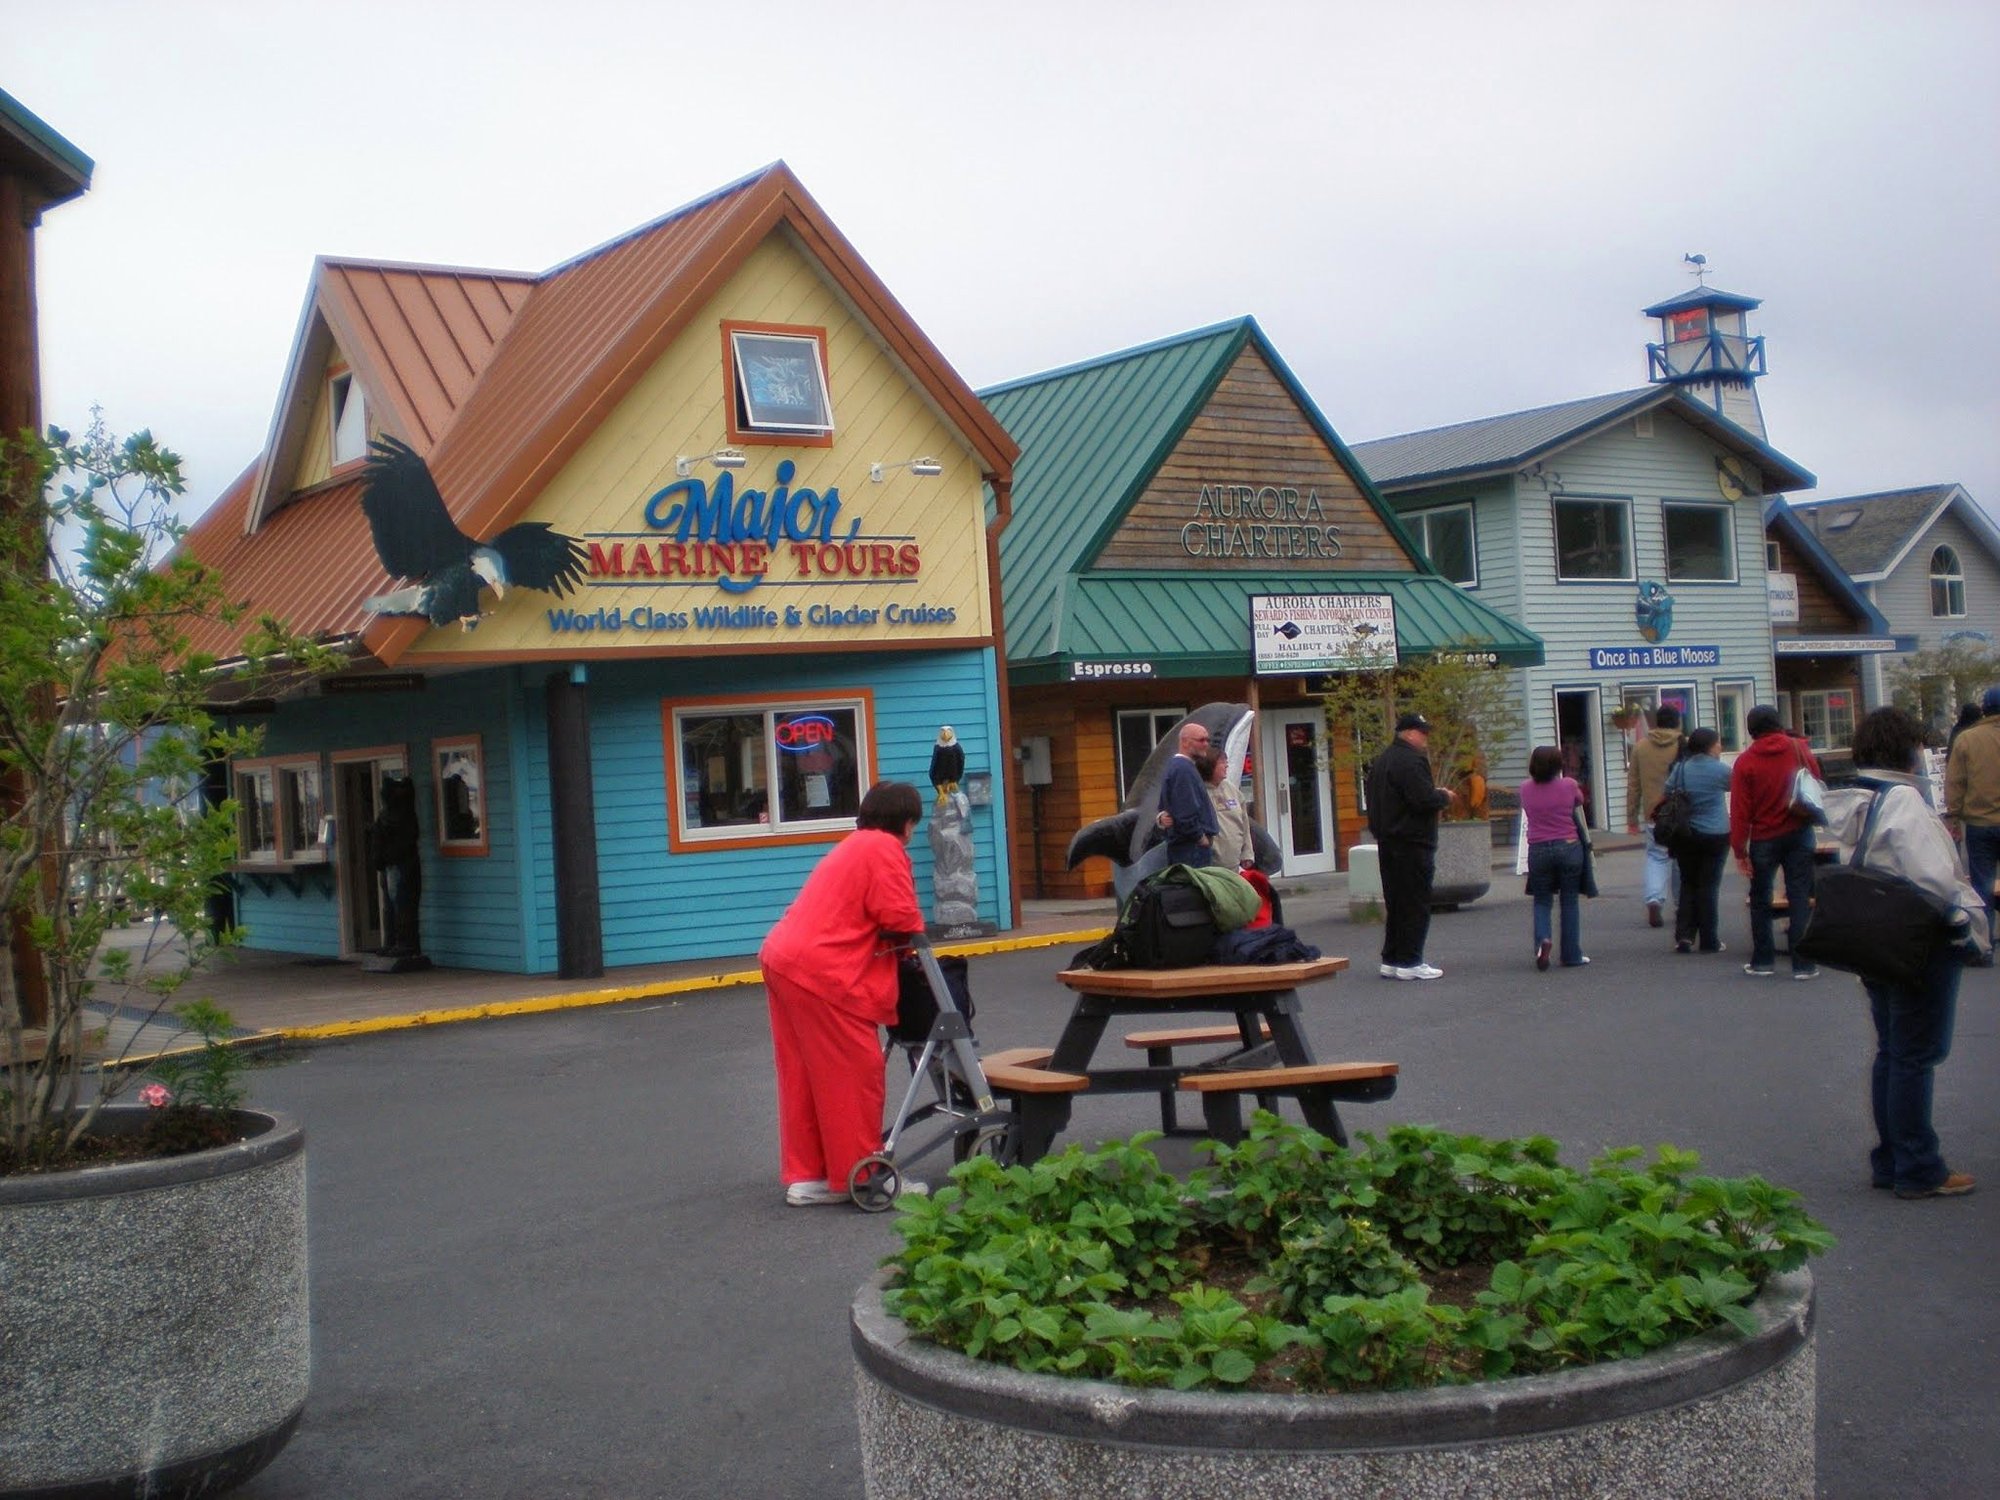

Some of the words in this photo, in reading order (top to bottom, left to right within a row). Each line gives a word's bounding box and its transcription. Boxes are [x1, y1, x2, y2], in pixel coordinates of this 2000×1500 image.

[1193, 484, 1327, 521] AURORA
[645, 459, 861, 594] Major
[1181, 521, 1343, 559] CHARTERS
[588, 542, 769, 577] MARINE
[791, 542, 921, 576] TOURS
[1265, 597, 1317, 609] AURORA
[1319, 596, 1382, 608] CHARTERS
[547, 606, 689, 632] World-Class
[692, 604, 778, 629] Wildlife
[784, 604, 803, 628] &
[807, 604, 880, 626] Glacier
[885, 602, 957, 625] Cruises
[1254, 609, 1288, 621] SEWARD'S
[1289, 609, 1318, 621] FISHING
[1319, 608, 1365, 620] INFORMATION
[1365, 608, 1392, 619] CENTER
[1257, 631, 1270, 639] DAY
[1304, 625, 1350, 636] CHARTERS
[1279, 642, 1322, 652] HALIBUT
[1326, 642, 1334, 651] &
[1597, 650, 1626, 666] Once
[1629, 649, 1640, 665] in
[1644, 652, 1651, 665] a
[1654, 648, 1678, 664] Blue
[1681, 648, 1716, 664] Moose
[1074, 661, 1152, 678] Espresso
[776, 722, 833, 744] OPEN
